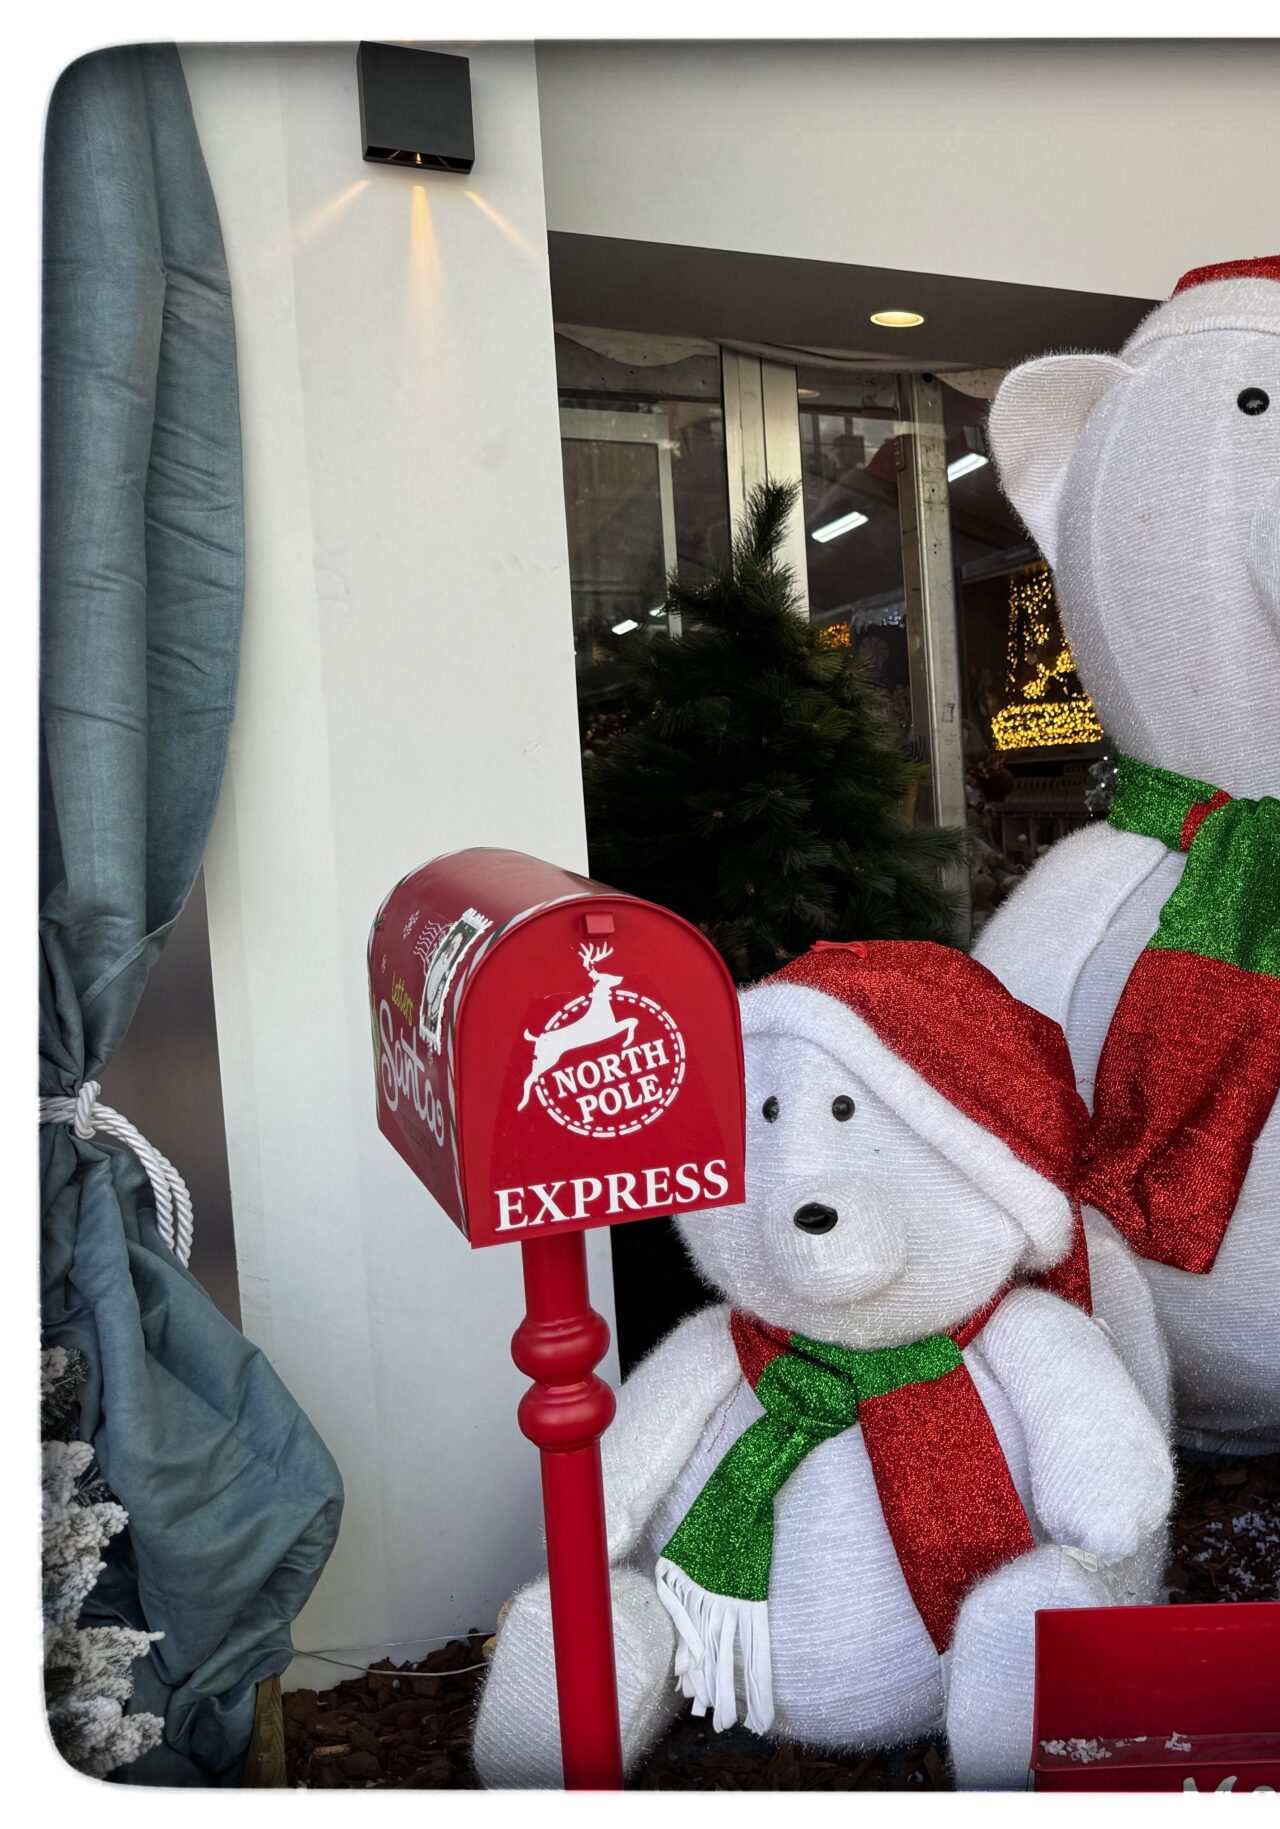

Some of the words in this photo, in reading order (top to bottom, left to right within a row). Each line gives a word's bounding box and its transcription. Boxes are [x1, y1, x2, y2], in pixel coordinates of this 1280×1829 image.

[379, 999, 444, 1147] Santa
[552, 1038, 669, 1099] NORTH
[576, 1073, 663, 1125] POLE
[494, 1159, 729, 1232] EXPRESS
